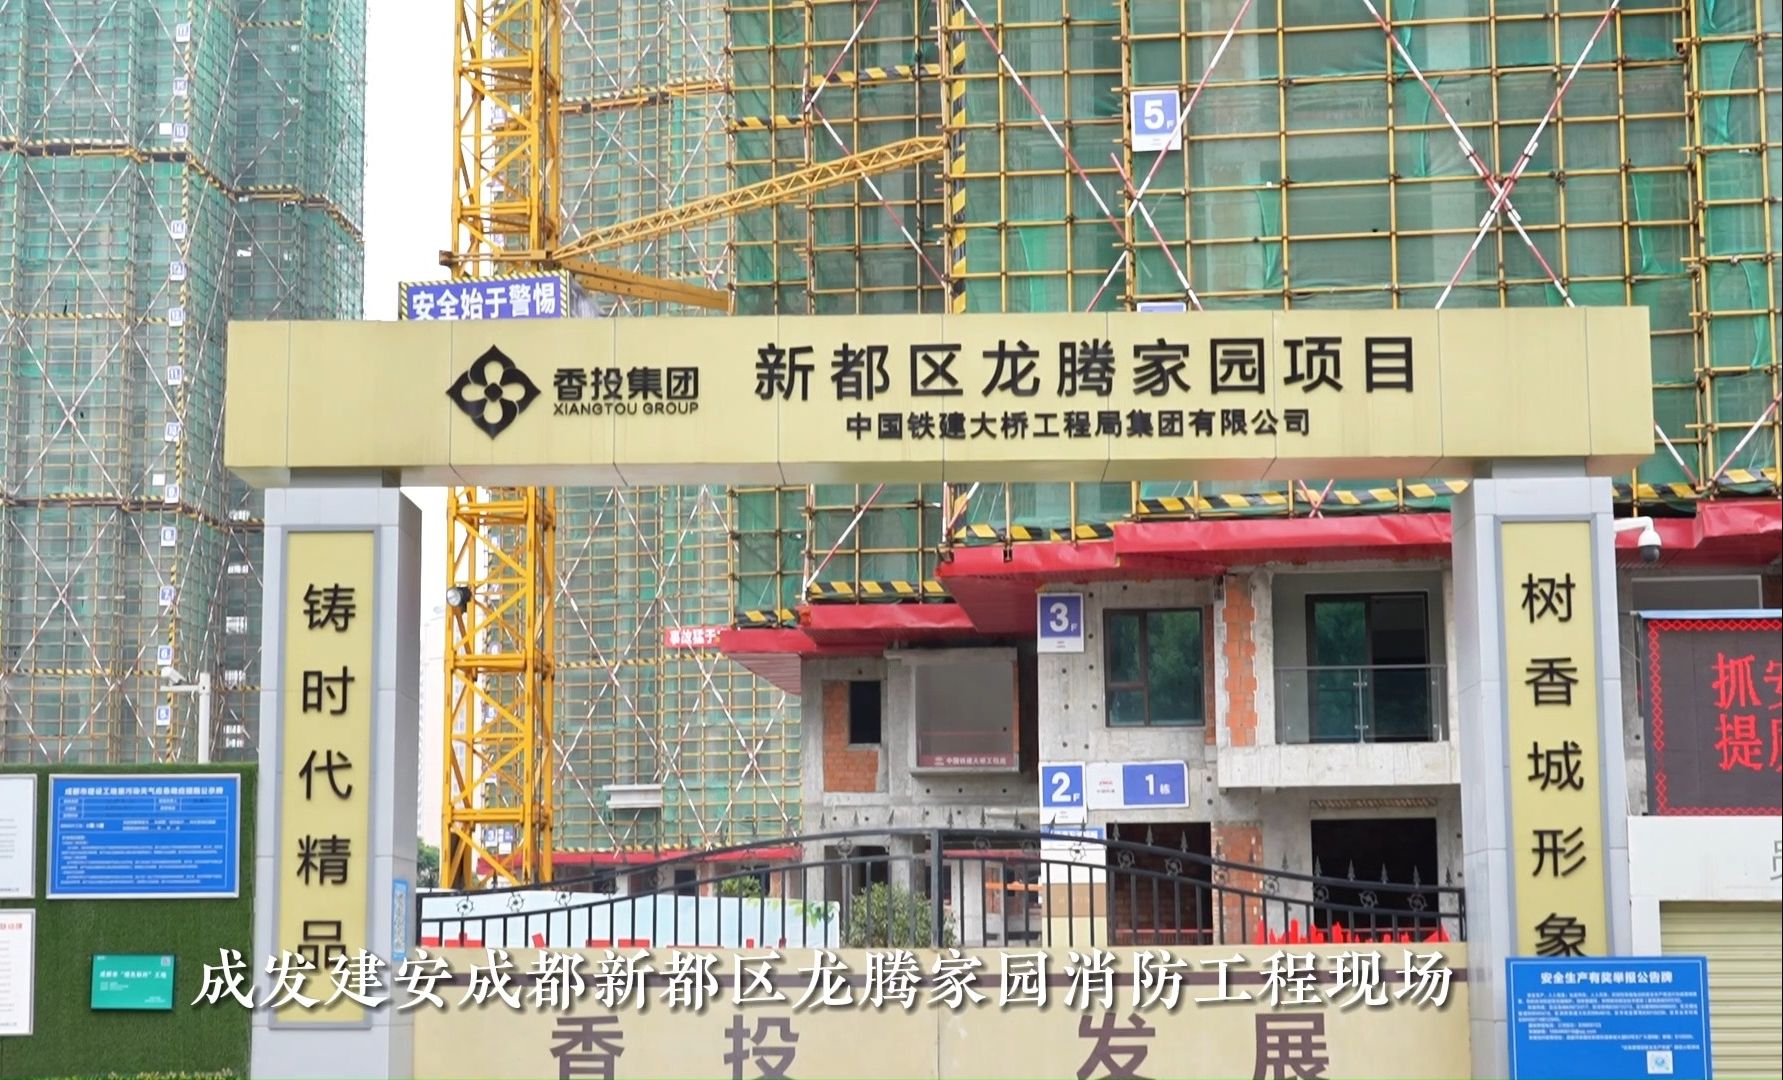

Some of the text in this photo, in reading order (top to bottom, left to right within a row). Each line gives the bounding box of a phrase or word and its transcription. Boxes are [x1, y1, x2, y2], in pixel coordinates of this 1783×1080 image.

[1144, 100, 1174, 129] 5F
[412, 282, 555, 320] 安全始于警惕
[553, 366, 700, 401] 香投集团
[755, 337, 1416, 402] 新都区龙腾家园项目
[553, 401, 699, 416] XIANGTOU GROUP
[846, 408, 1312, 441] 中国铁建大桥工程局集团有限公司
[1050, 602, 1078, 632] 3F
[669, 627, 721, 645] 事故猛于
[297, 583, 357, 968] 铸时代精品
[1519, 573, 1588, 957] 树香城形象
[1051, 771, 1080, 802] 2F
[1540, 971, 1673, 985] 安全生产有奖举报公告牌
[549, 1011, 1330, 1079] 香投 发展
